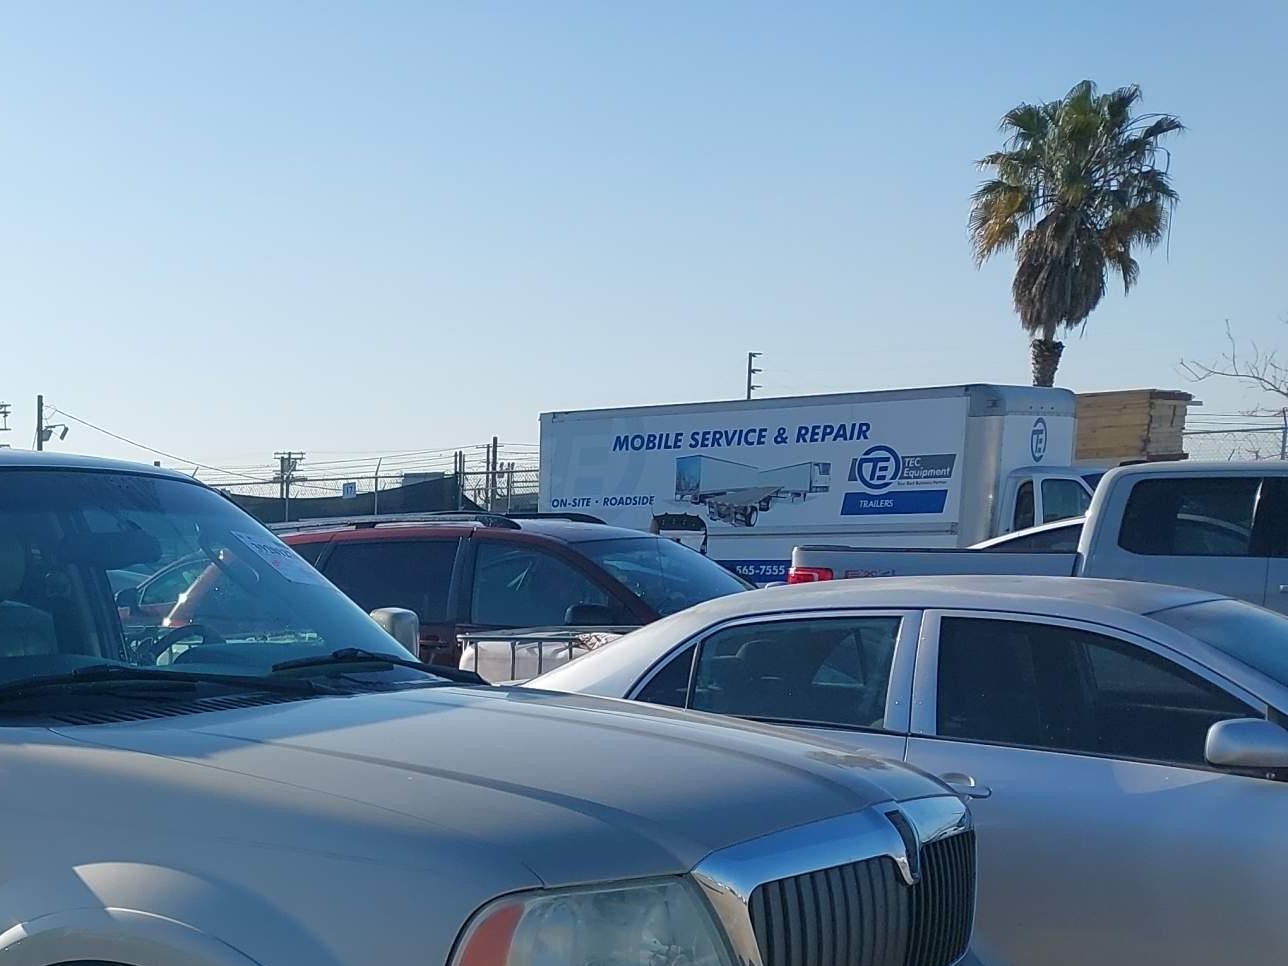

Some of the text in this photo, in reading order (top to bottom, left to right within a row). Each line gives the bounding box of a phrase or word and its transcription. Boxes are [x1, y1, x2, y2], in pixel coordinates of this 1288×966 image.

[612, 422, 871, 452] MOBILE SERVICE & REPAIR
[904, 458, 922, 467] TEC
[903, 467, 951, 479] Equipment
[552, 496, 655, 508] ON-SITE ROADSIDE
[859, 499, 894, 508] TRAILERS
[736, 565, 785, 575] 565-7555
